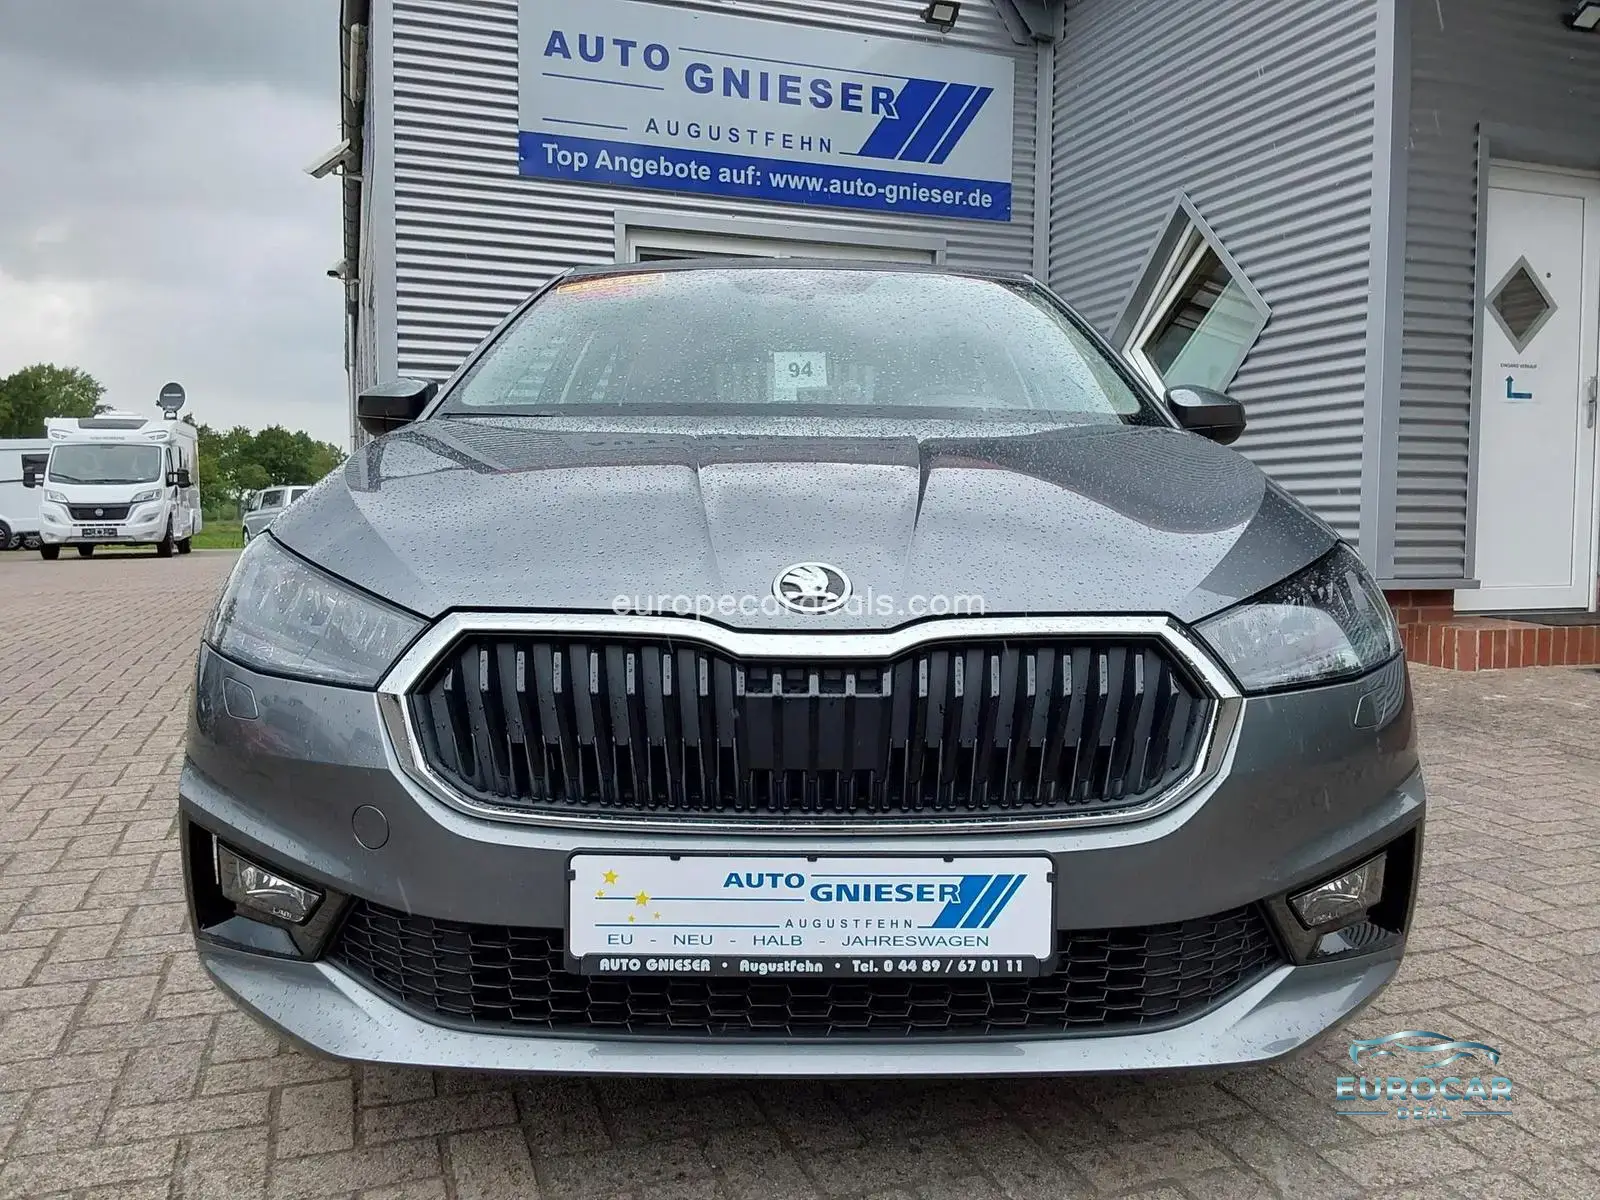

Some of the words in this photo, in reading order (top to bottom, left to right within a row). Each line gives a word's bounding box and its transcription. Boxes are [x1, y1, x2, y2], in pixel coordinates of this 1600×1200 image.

[543, 30, 670, 71] AUTO
[684, 62, 899, 119] GNIESER
[645, 118, 831, 153] AUGUSTFEHN
[542, 143, 588, 171] Top
[594, 149, 711, 179] Angebote
[718, 165, 761, 186] auf:
[768, 171, 993, 208] www.auto-gnieser.de
[788, 361, 813, 378] 94
[723, 873, 805, 889] AUTO
[810, 883, 961, 902] GNIESER
[785, 919, 913, 929] AUGUSTFEHN
[607, 934, 633, 945] EU
[673, 934, 713, 946] NEU
[753, 935, 803, 946] HALB
[841, 935, 989, 947] JAHRESWAGEN
[600, 958, 641, 971] AUTO
[646, 958, 711, 972] GNIESER
[739, 960, 823, 975] Augustfehn
[852, 959, 878, 972] Tel.
[883, 959, 894, 972] 0
[898, 959, 917, 972] 44
[922, 959, 941, 972] 89
[957, 959, 978, 972] 67
[981, 959, 998, 972] 01
[1006, 959, 1023, 972] 11
